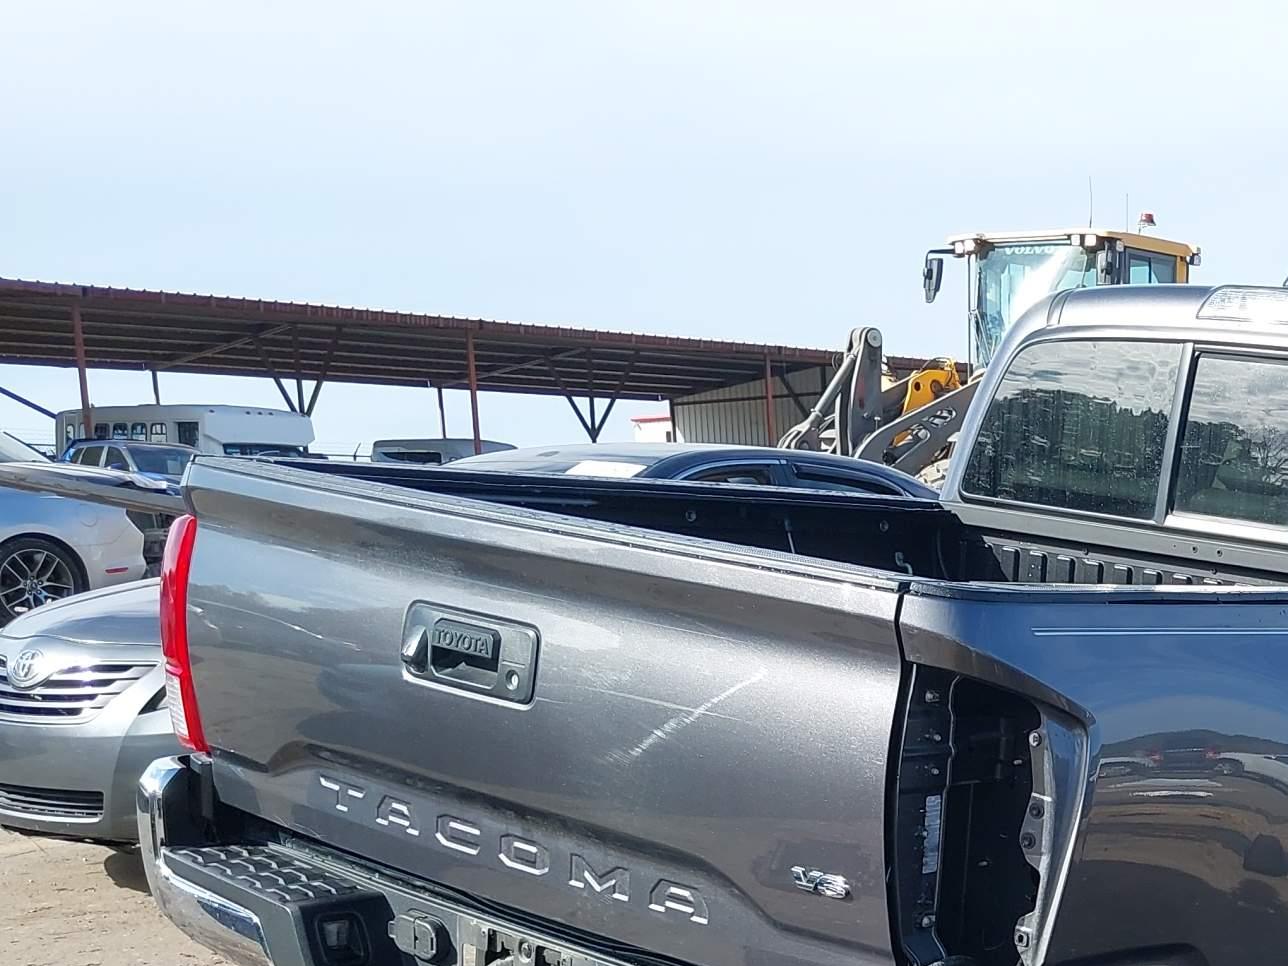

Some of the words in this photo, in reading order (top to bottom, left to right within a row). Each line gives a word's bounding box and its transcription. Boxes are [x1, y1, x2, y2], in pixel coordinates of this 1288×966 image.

[1003, 245, 1055, 256] VOLVO
[433, 627, 490, 656] TOYOTA
[318, 772, 711, 926] TACOMA
[790, 864, 851, 899] V6
